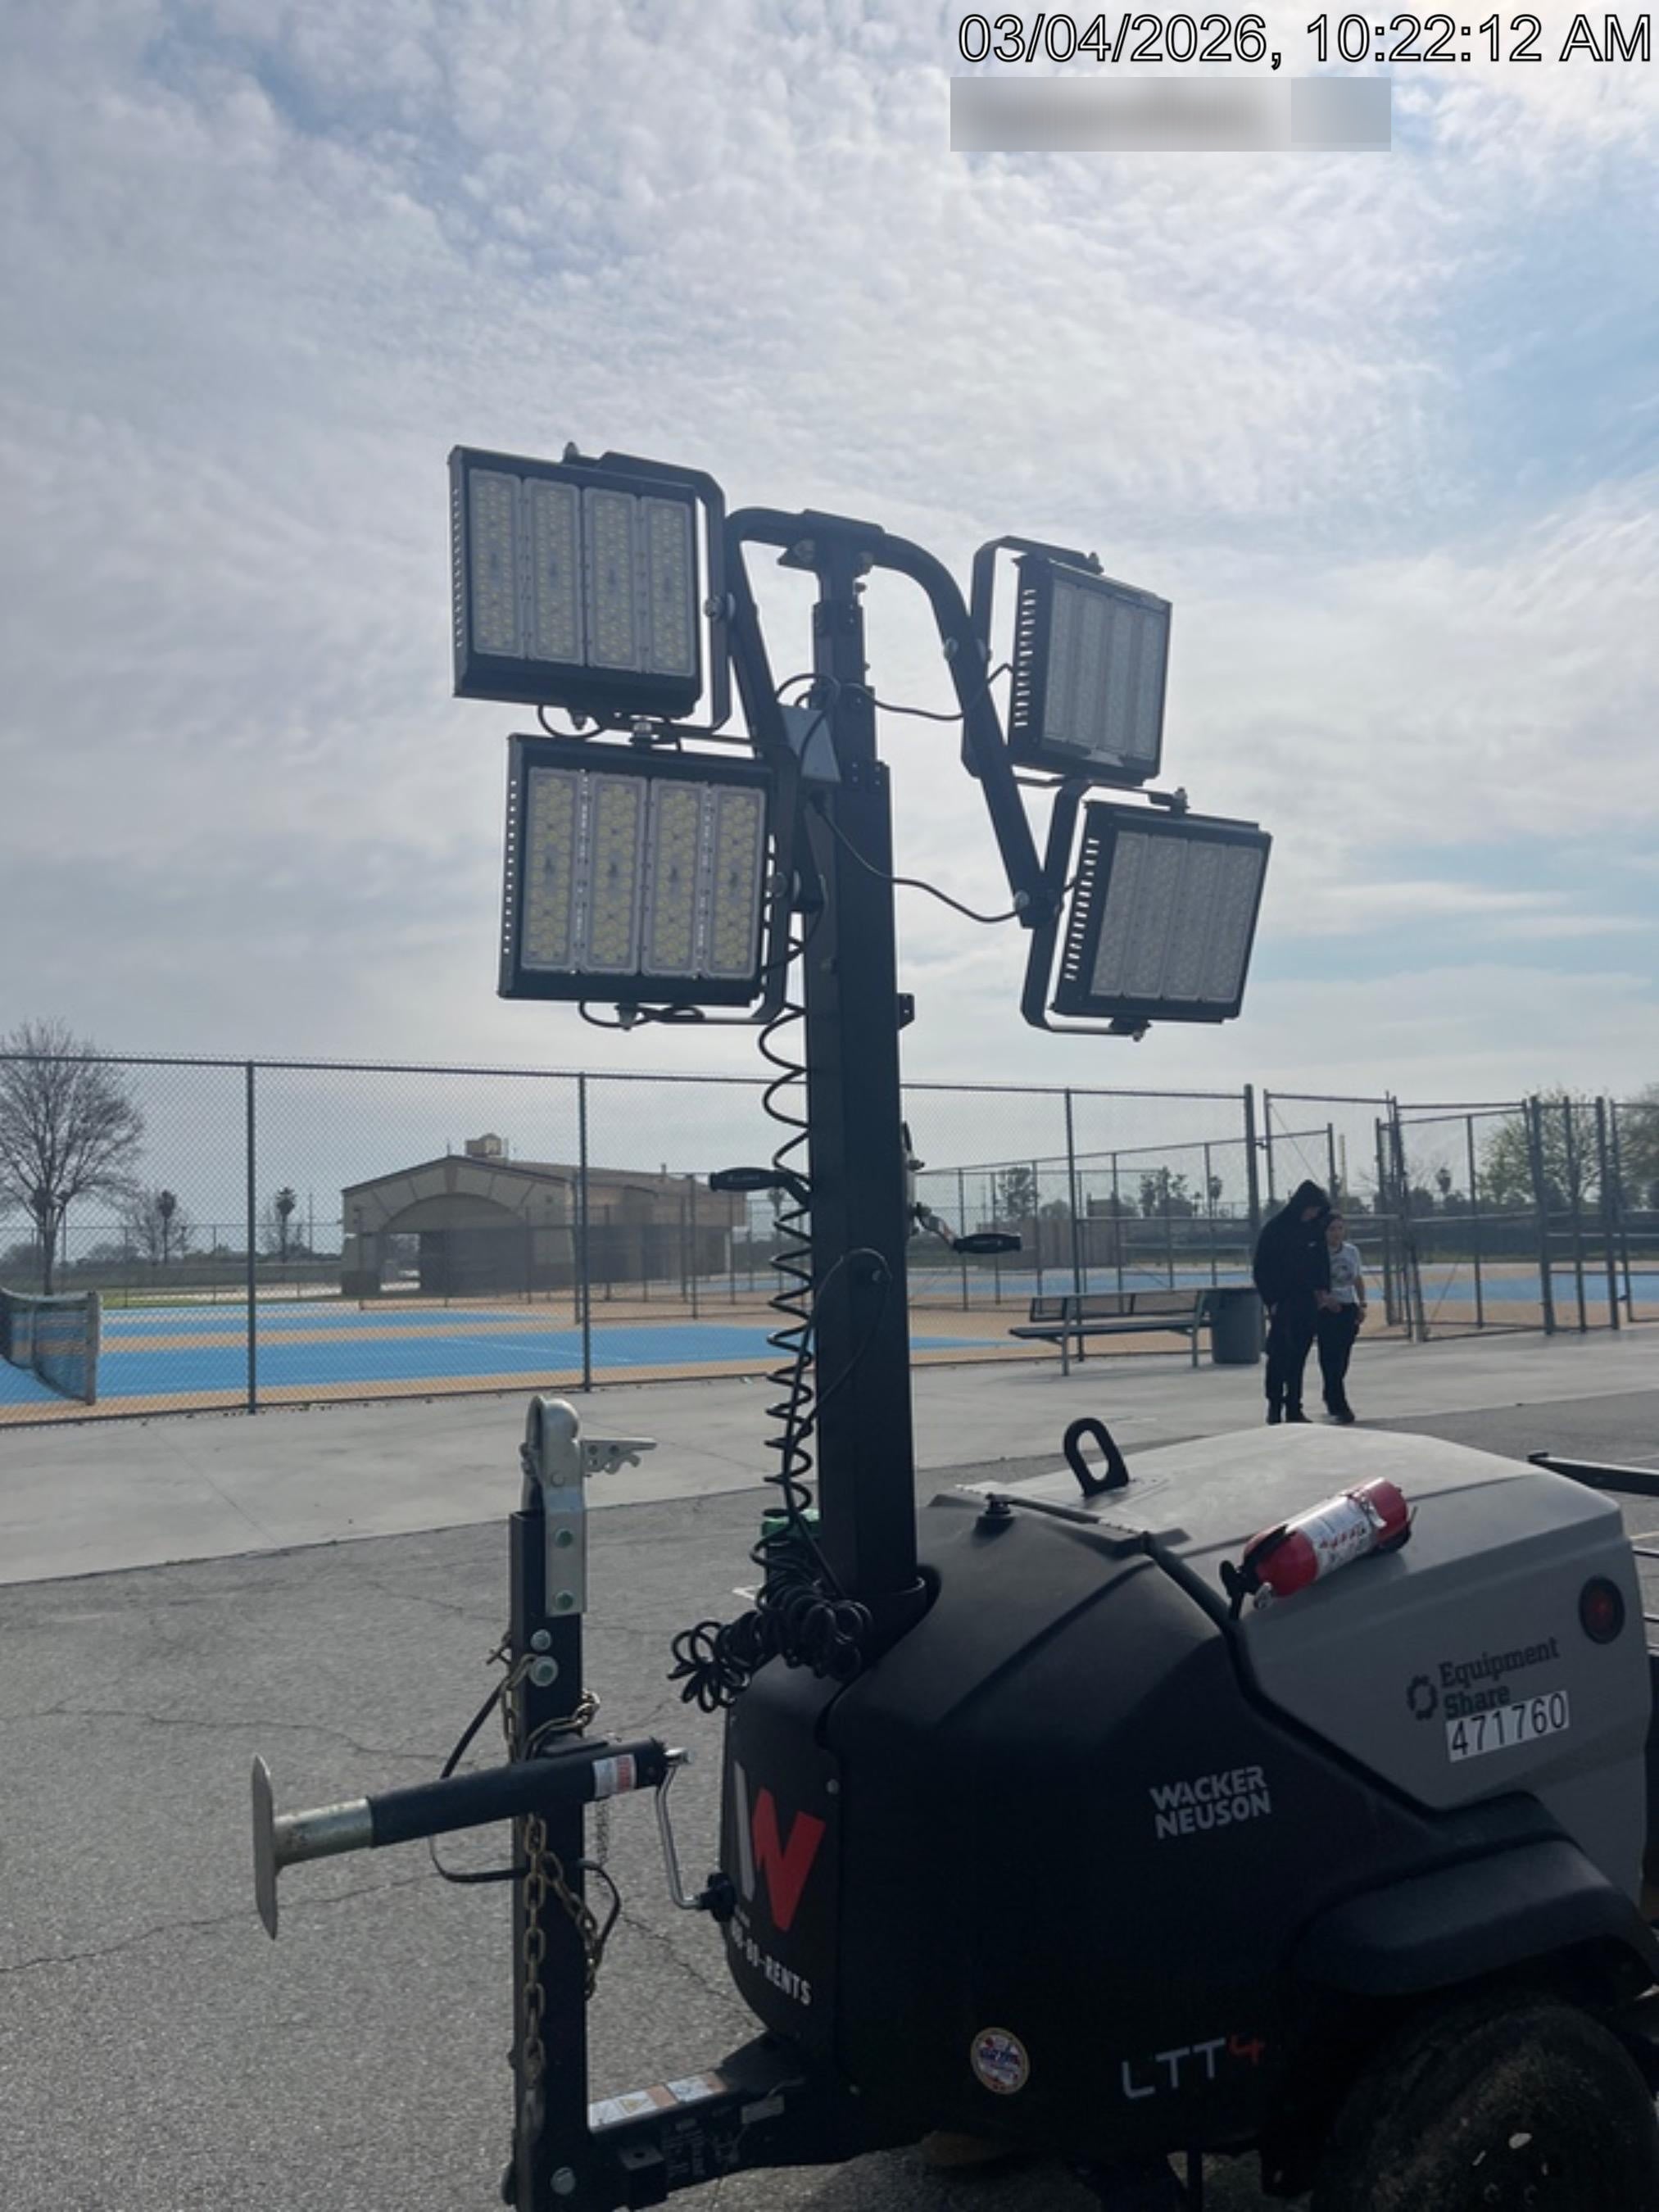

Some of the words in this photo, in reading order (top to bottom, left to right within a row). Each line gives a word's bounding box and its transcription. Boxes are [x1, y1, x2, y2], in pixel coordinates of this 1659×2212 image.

[1439, 1637, 1560, 1688] Equipment
[1444, 1685, 1510, 1720] Share
[1453, 1693, 1565, 1755] 471760
[1149, 1766, 1267, 1811] WACKER
[1155, 1789, 1271, 1839] NEUSON
[1121, 2033, 1264, 2100] LTT4
